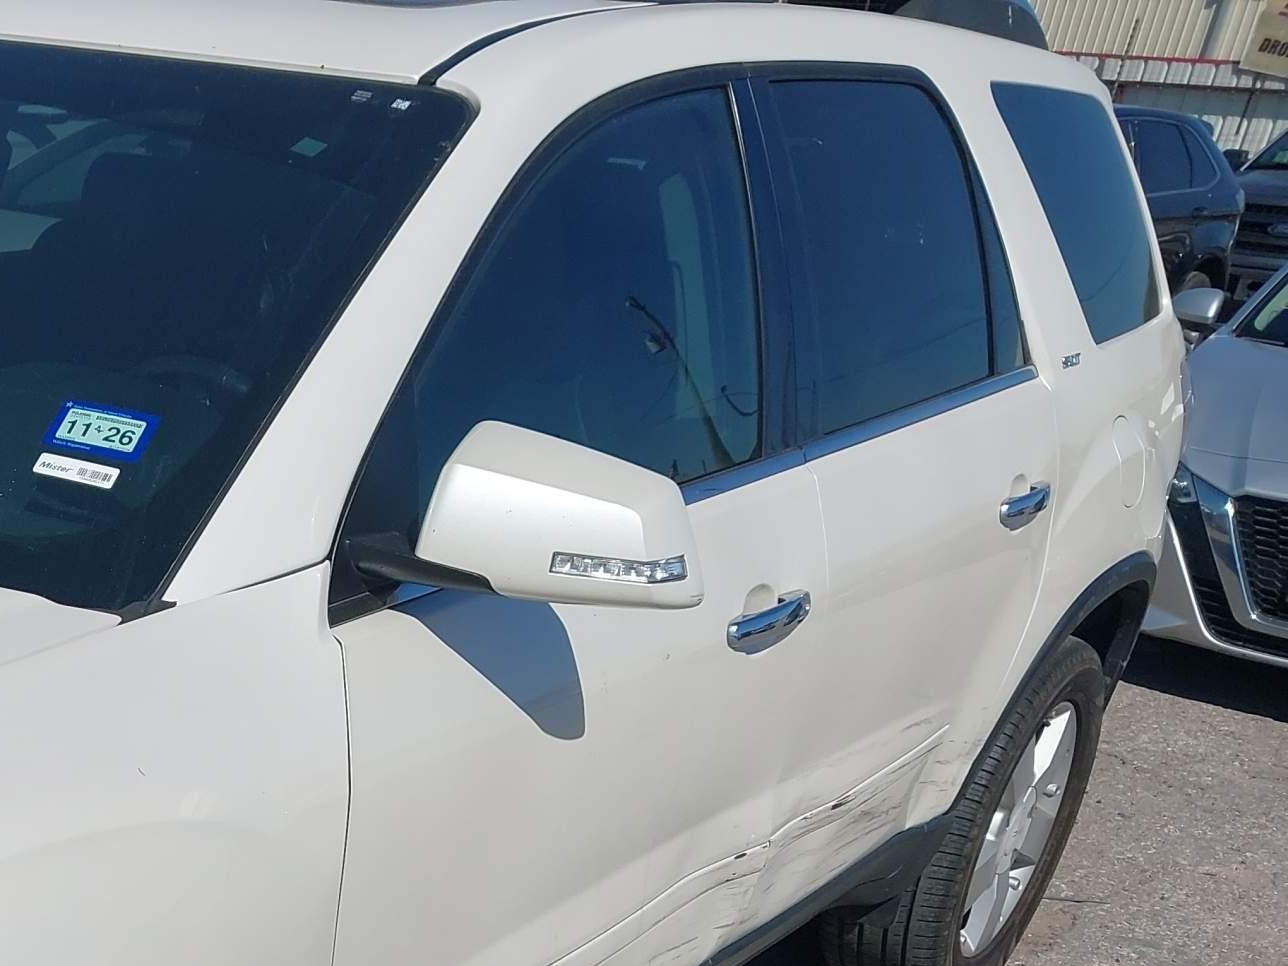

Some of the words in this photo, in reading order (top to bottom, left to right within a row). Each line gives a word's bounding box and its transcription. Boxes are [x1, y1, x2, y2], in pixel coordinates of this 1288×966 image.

[1258, 37, 1288, 57] DRO
[67, 419, 93, 437] 11
[102, 426, 137, 446] 26
[39, 461, 72, 473] Mister
